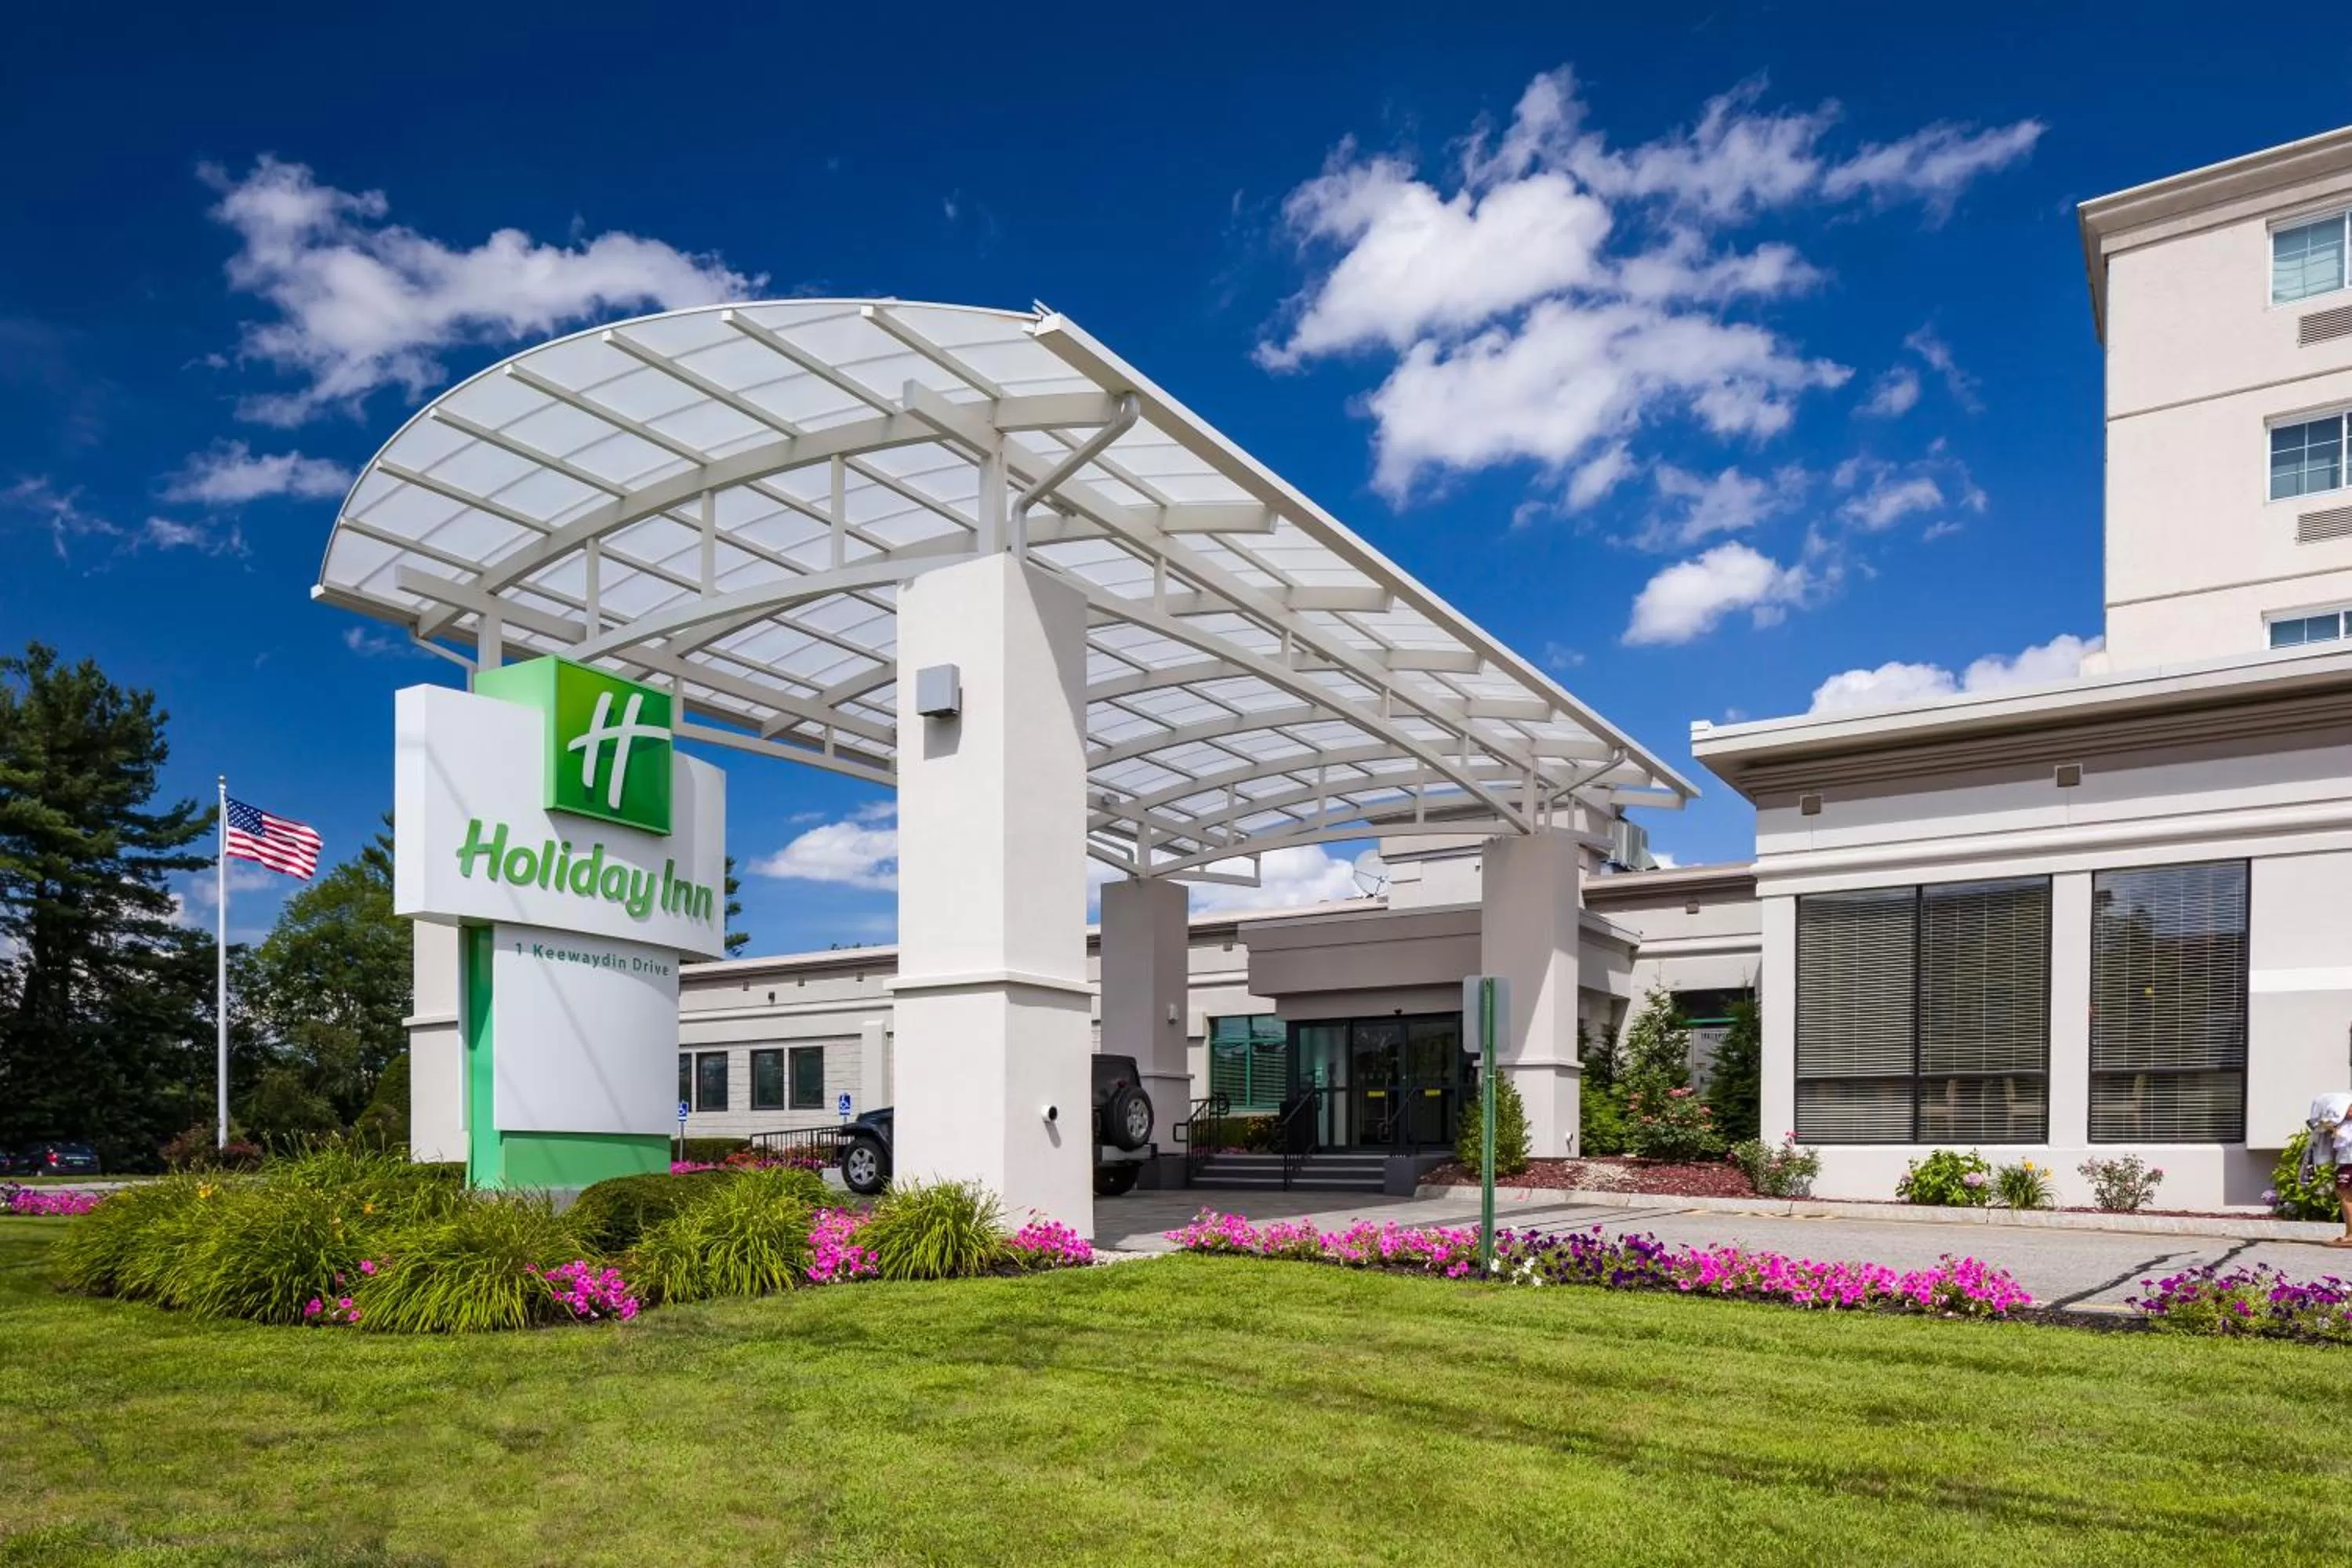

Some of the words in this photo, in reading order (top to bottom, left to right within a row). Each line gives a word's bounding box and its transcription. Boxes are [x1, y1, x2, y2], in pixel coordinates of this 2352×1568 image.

[567, 691, 672, 810] H
[456, 818, 657, 918] Holiday
[661, 858, 713, 923] Inn
[515, 942, 523, 956] 1
[532, 943, 627, 969] Keewaydin
[633, 957, 670, 976] Drive
